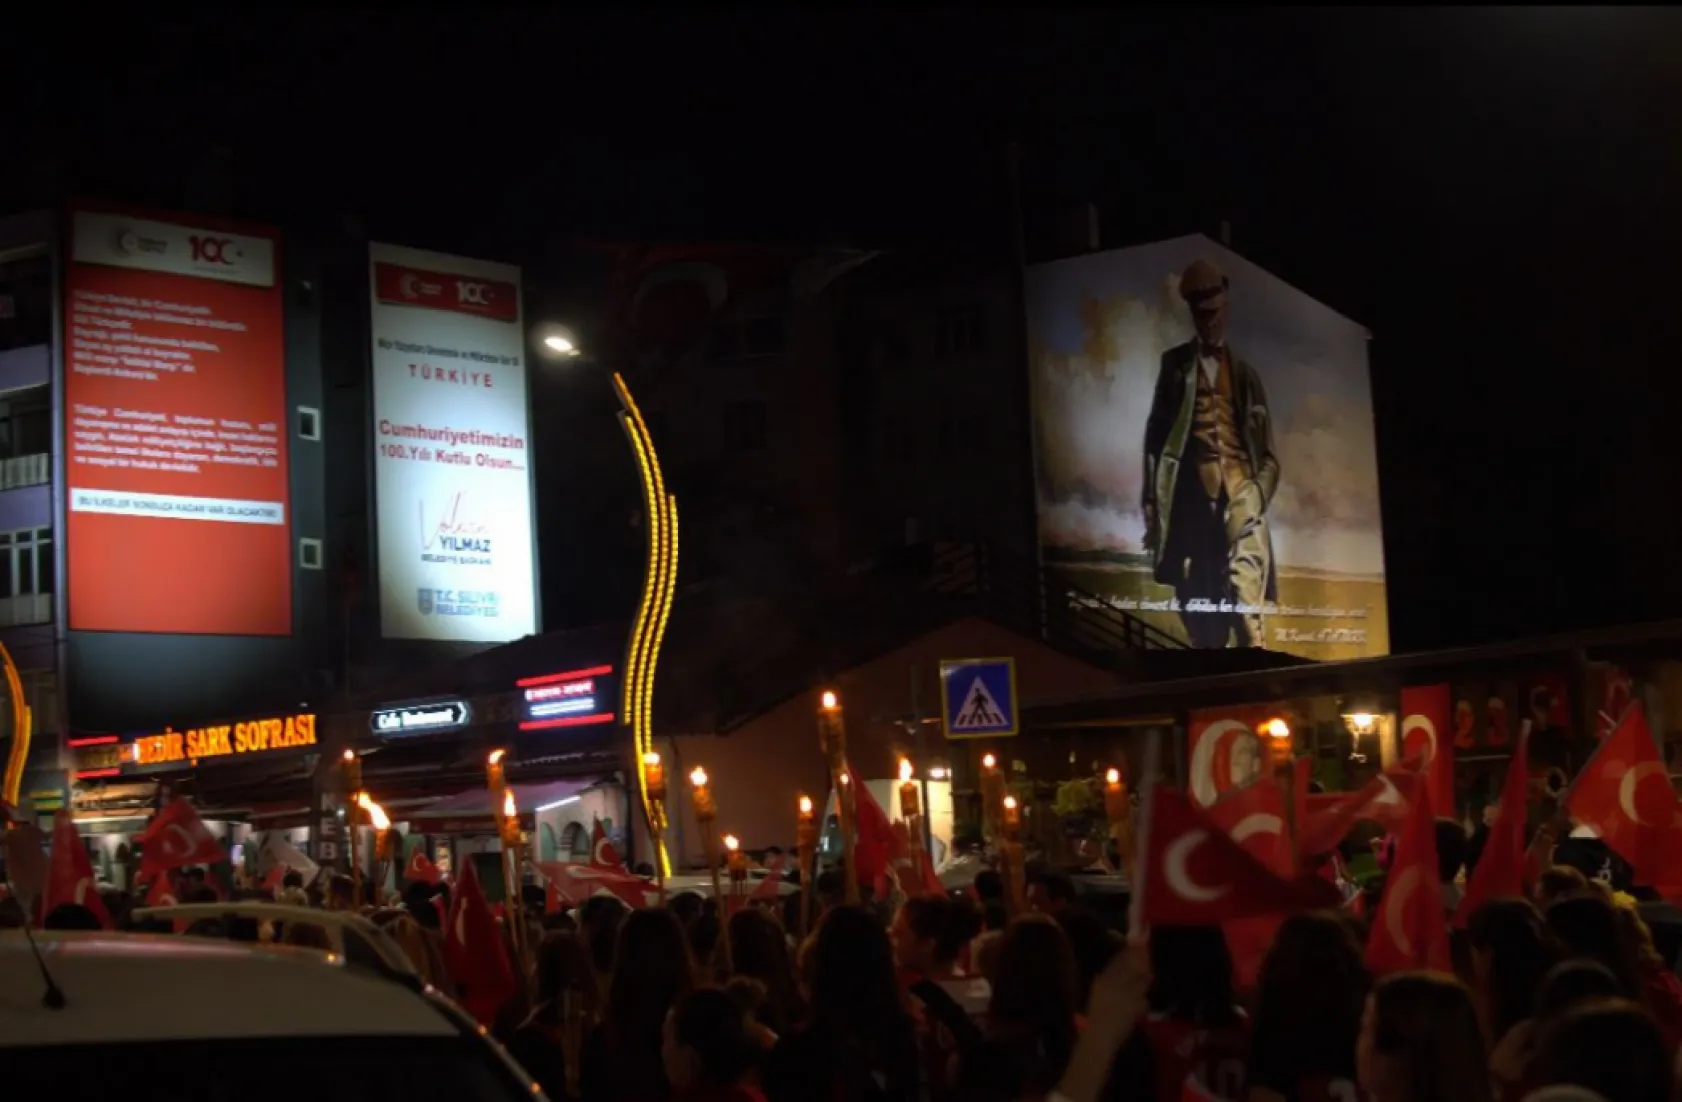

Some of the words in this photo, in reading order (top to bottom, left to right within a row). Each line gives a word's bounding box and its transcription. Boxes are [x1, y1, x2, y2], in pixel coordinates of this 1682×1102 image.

[408, 364, 493, 387] TÜRKİYE
[379, 420, 524, 449] Cumhuriyetimizin
[436, 448, 471, 466] Kutlu
[439, 535, 491, 553] YILMAZ
[186, 725, 233, 766] ŞARK
[235, 714, 316, 752] SOFRASI
